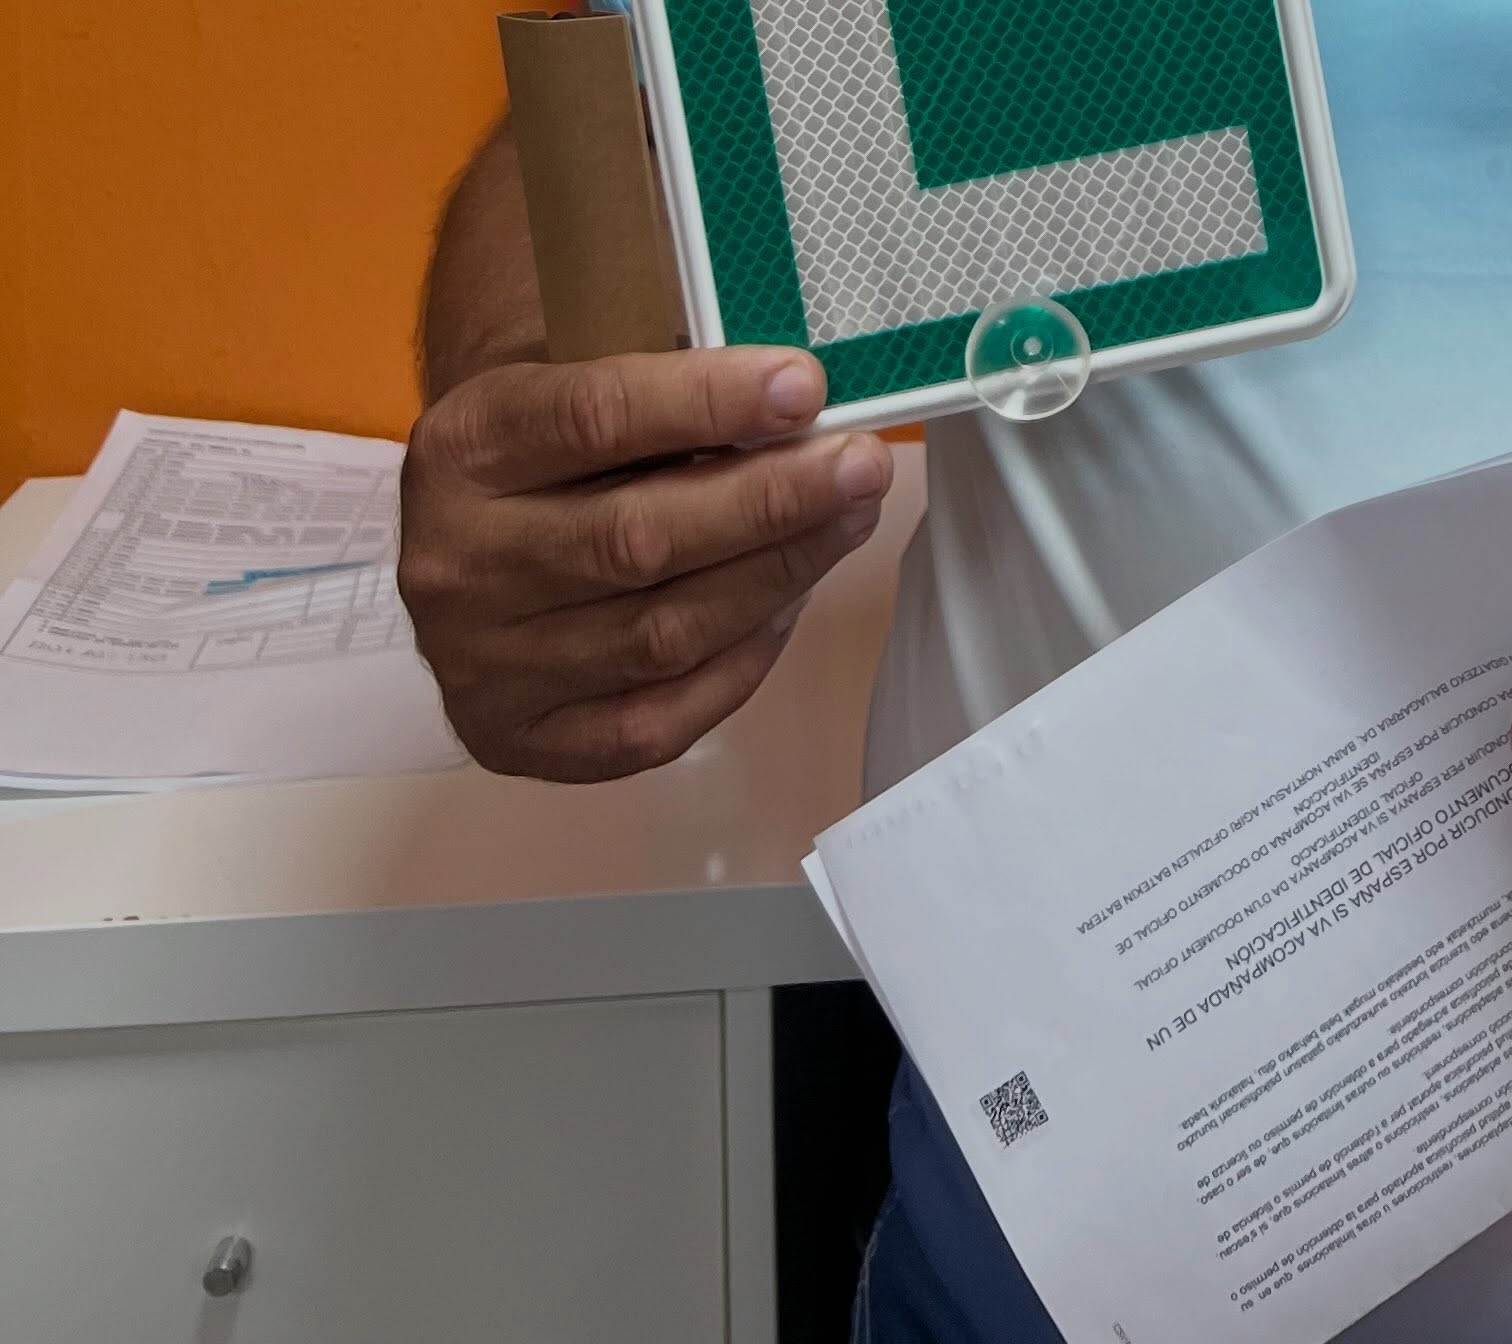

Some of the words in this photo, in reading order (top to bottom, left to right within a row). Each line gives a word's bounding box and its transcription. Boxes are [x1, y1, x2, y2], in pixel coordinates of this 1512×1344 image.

[1449, 656, 1508, 687] GIDATZEKO
[1376, 682, 1449, 731] BALIAGARRIA
[1438, 696, 1497, 734] CONDUCIR
[1321, 740, 1356, 767] BAINA
[1413, 729, 1439, 750] POR
[1464, 729, 1512, 765] ONDUIR
[1350, 776, 1368, 793] SE
[1440, 760, 1465, 781] PER
[1260, 764, 1322, 810] NORTASUN
[1332, 789, 1353, 806] VAI
[1379, 771, 1423, 802] OFICIAL
[1387, 776, 1441, 815] ESPANYA
[1229, 805, 1259, 832] AGIRI
[1358, 821, 1377, 835] VA
[1376, 811, 1389, 825] SI
[1171, 828, 1228, 871] OFIZIALEN
[1250, 844, 1269, 861] DO
[1372, 819, 1433, 864] OFICIAL
[1411, 833, 1448, 864] POR
[1122, 866, 1171, 904] BATEKIN
[1178, 857, 1250, 911] DOCUMENTO
[1347, 860, 1373, 884] DE
[1348, 858, 1412, 907] ESPAÑA
[1076, 899, 1122, 933] BATERA
[1132, 907, 1177, 940] OFICIAL
[1225, 877, 1348, 970] IDENTIFICACIÓN
[1306, 916, 1332, 936] VA
[1331, 903, 1348, 922] SI
[1115, 936, 1133, 955] DE
[1181, 911, 1243, 961] DOCUMENT
[1133, 957, 1178, 990] OFICIAL
[1196, 930, 1304, 1013] ACOMPAÑADA
[1171, 1008, 1197, 1033] DE
[1146, 1026, 1172, 1051] UN
